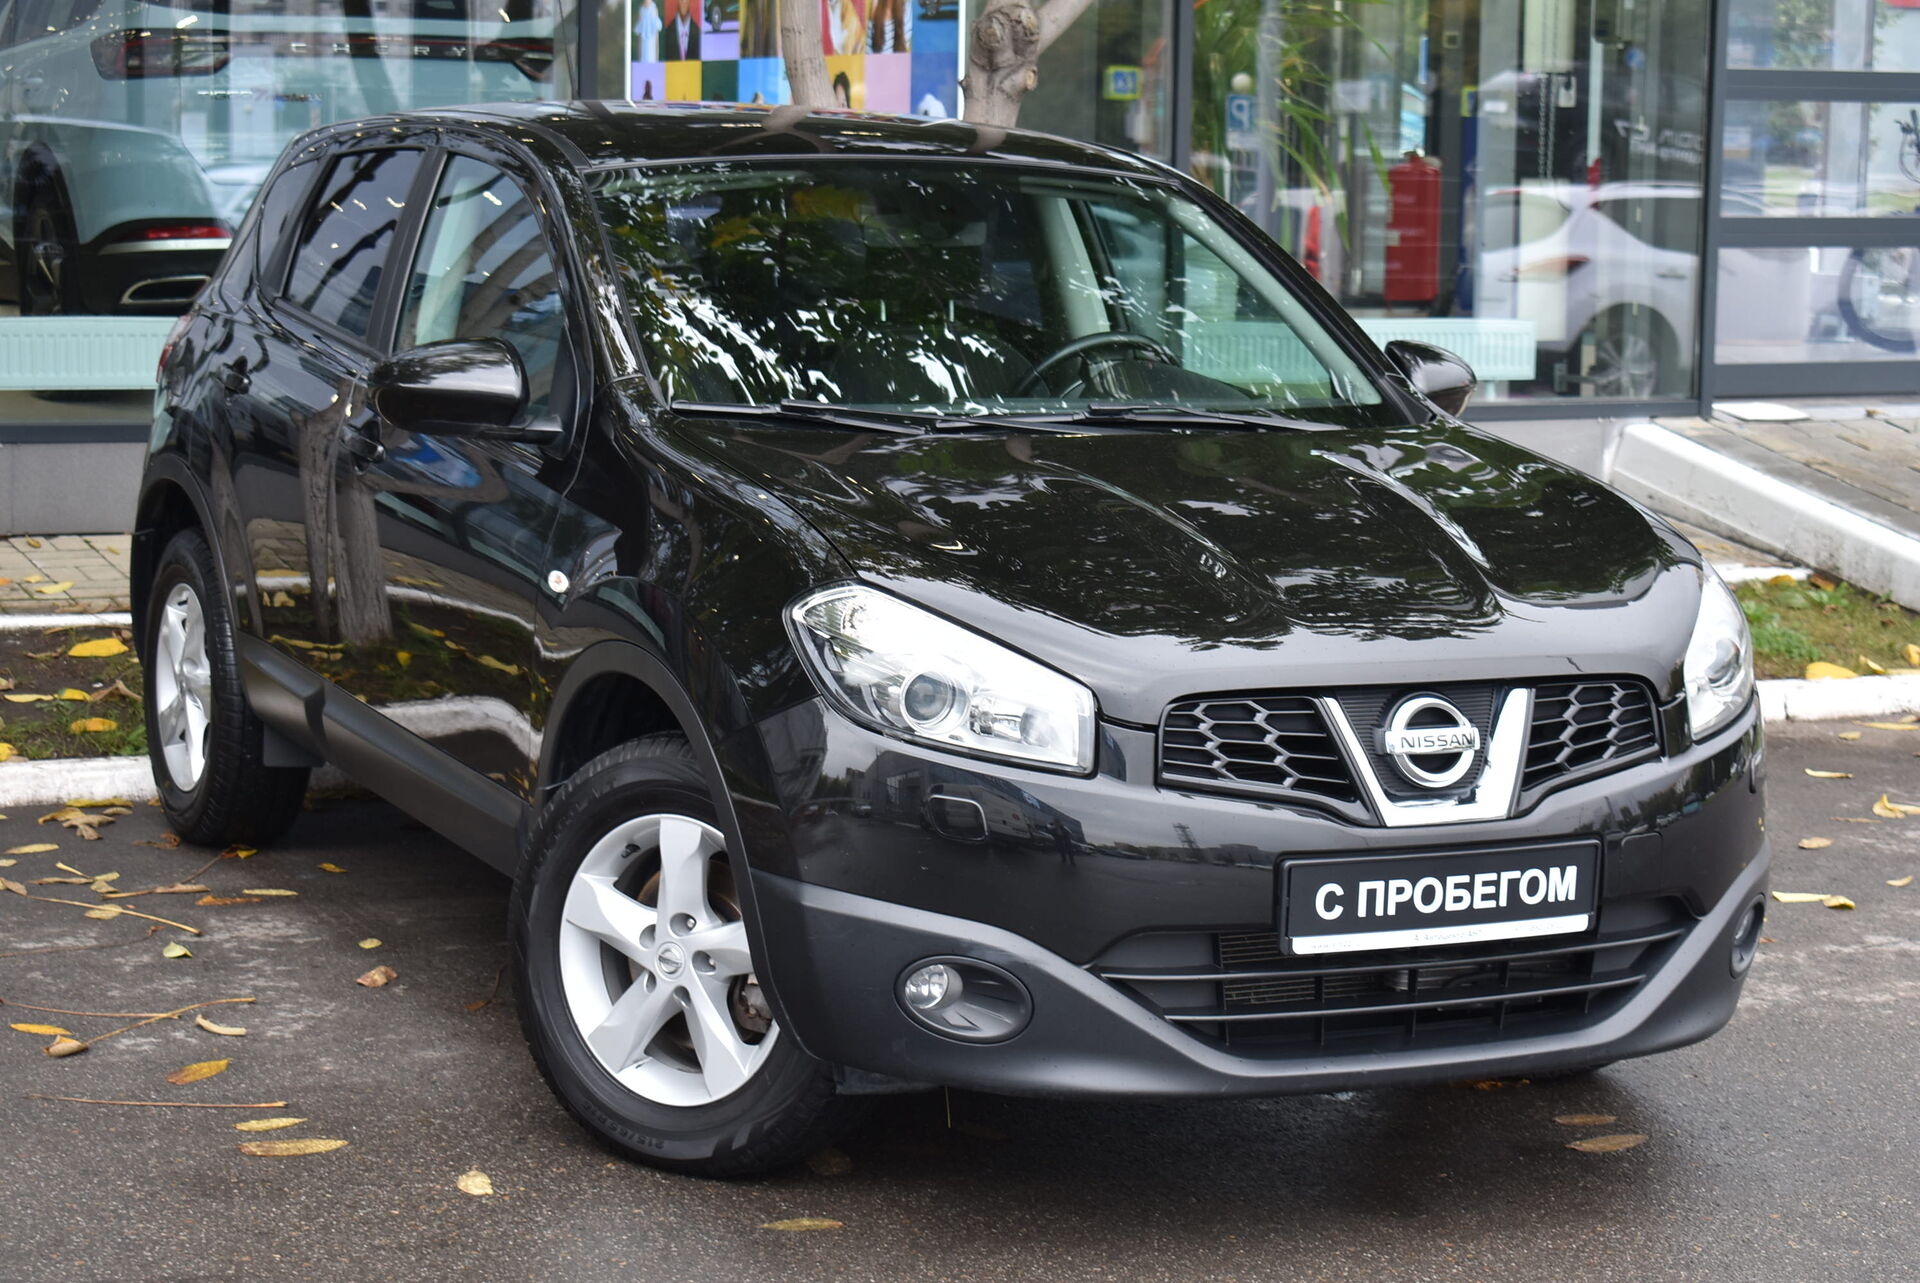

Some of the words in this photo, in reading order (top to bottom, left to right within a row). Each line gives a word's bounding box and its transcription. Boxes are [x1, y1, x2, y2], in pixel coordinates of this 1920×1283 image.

[290, 42, 467, 57] CHERY
[1401, 732, 1475, 750] NISSAN
[1315, 882, 1345, 921] С
[1356, 864, 1578, 918] ПРОБЕГОМ
